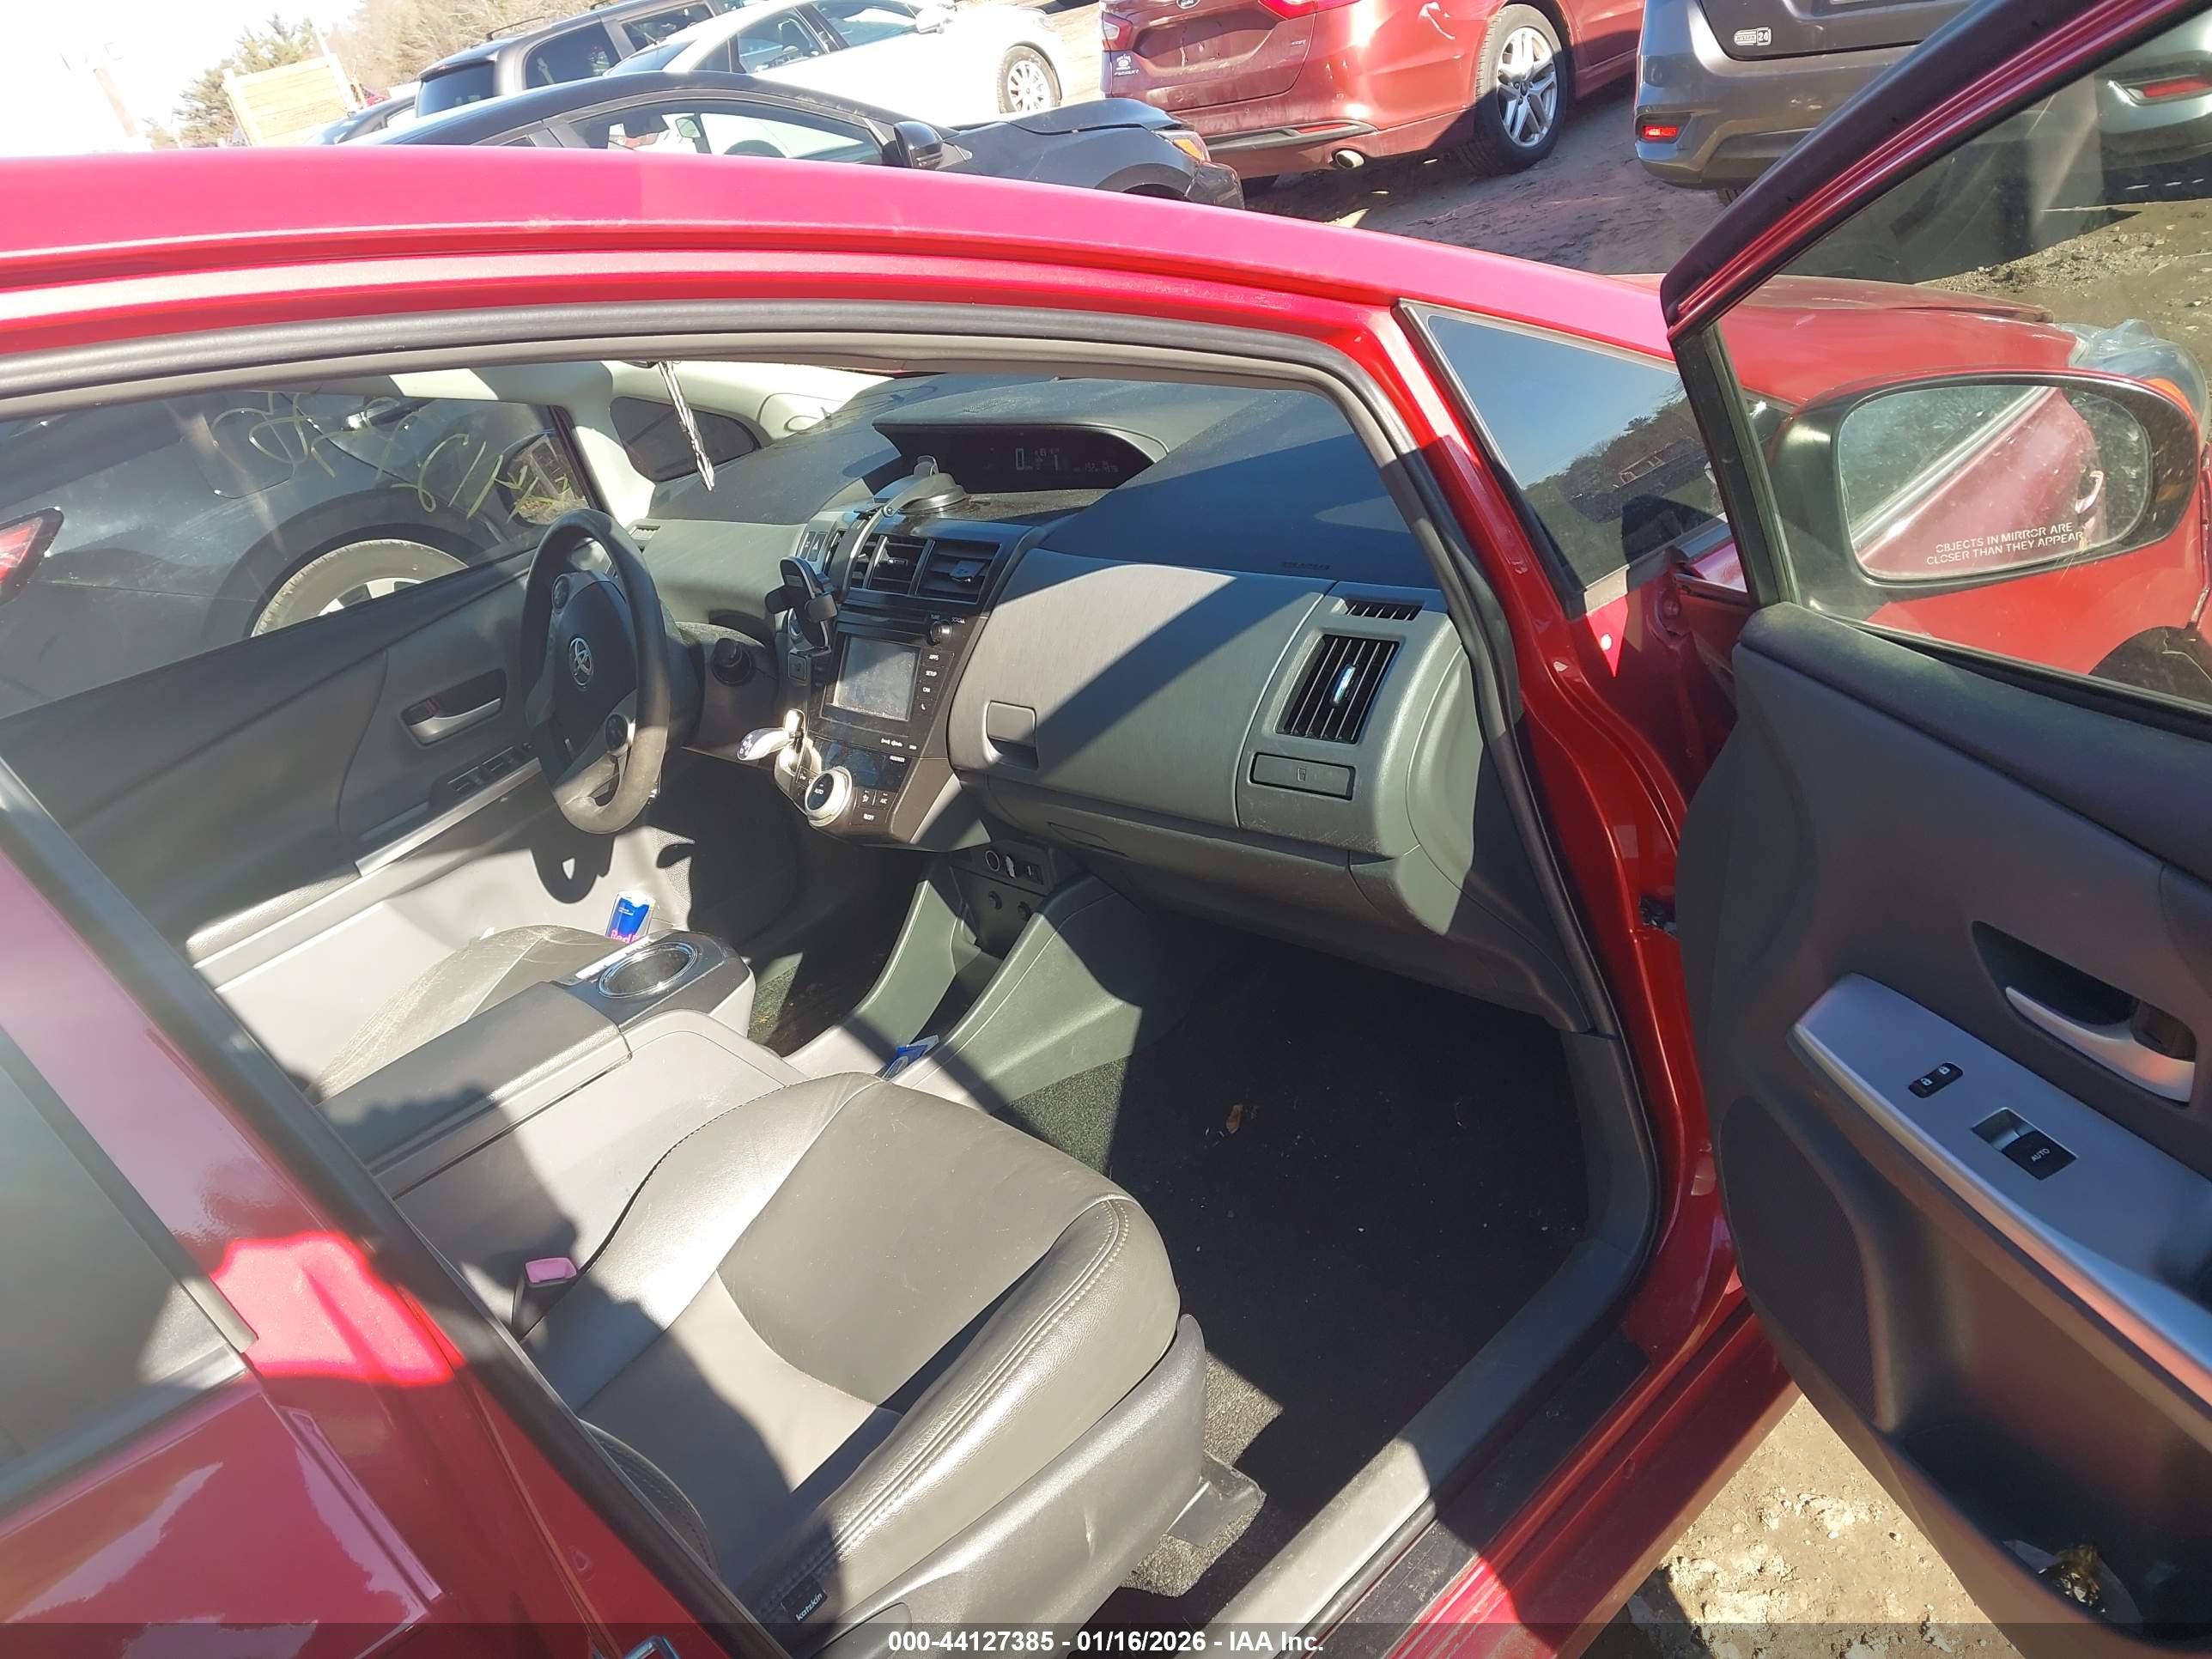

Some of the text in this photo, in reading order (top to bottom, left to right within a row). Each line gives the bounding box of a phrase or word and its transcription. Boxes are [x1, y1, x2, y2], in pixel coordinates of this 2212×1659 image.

[1758, 31, 1769, 41] 24
[1936, 522, 2073, 554] OBJECTS IN MIRROR ARE
[1926, 531, 2084, 566] CLOSER THAN THEY APPEAR
[611, 929, 632, 944] Red
[2031, 1148, 2051, 1162] AUTO
